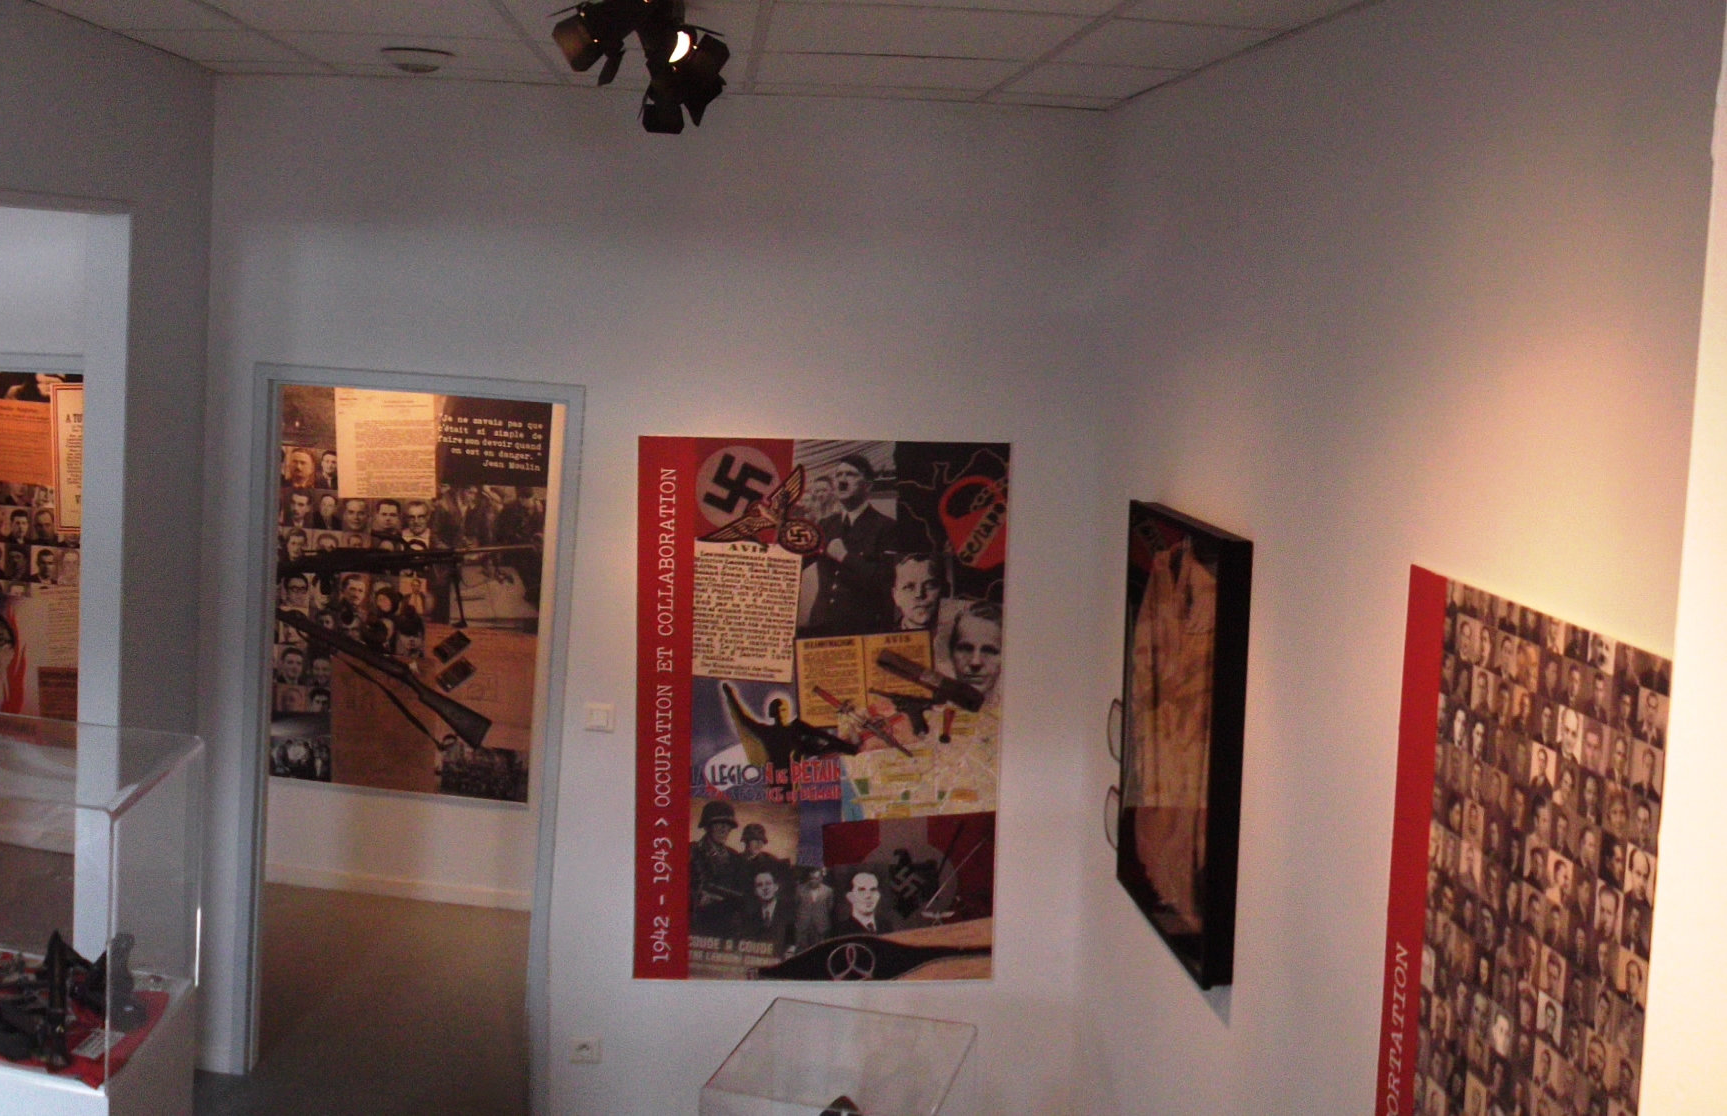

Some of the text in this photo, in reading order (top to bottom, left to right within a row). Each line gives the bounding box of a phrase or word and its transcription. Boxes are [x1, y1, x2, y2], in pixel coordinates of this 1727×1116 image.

[482, 439, 513, 448] devoir
[515, 442, 542, 450] quand
[527, 422, 543, 430] que
[483, 460, 541, 471] Jean Moulin
[658, 468, 677, 636] COLLABORATION
[657, 647, 673, 673] ET
[655, 684, 672, 808] OCCUPATION
[651, 837, 672, 884] 1943
[650, 916, 671, 963] 1942
[1385, 941, 1408, 1116] ORTATION
